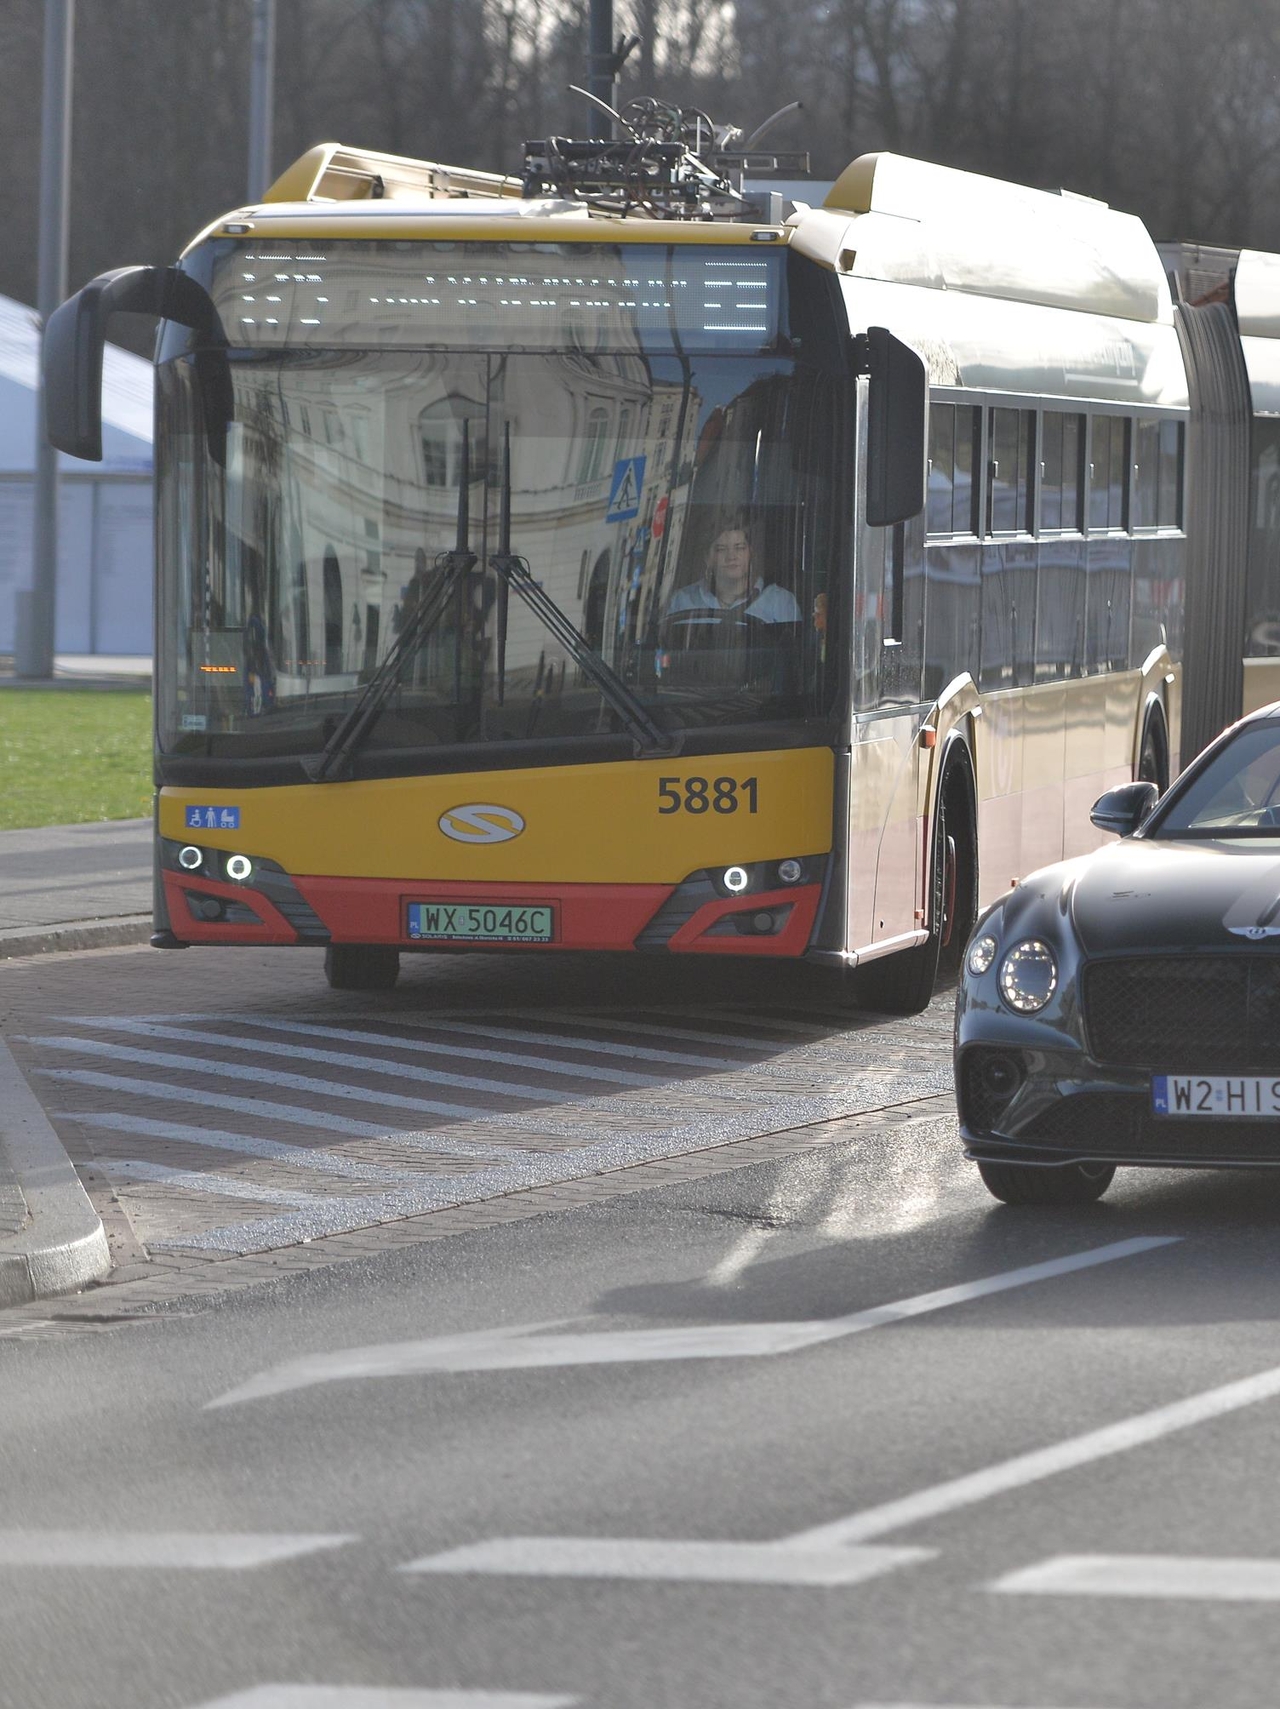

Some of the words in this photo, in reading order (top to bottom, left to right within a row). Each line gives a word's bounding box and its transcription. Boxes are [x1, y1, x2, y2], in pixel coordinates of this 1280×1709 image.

[658, 776, 758, 814] 5881
[410, 921, 419, 929] PL
[426, 907, 457, 932] WX
[468, 908, 545, 934] 5046C
[1155, 1098, 1167, 1108] PL
[1174, 1079, 1212, 1110] W2
